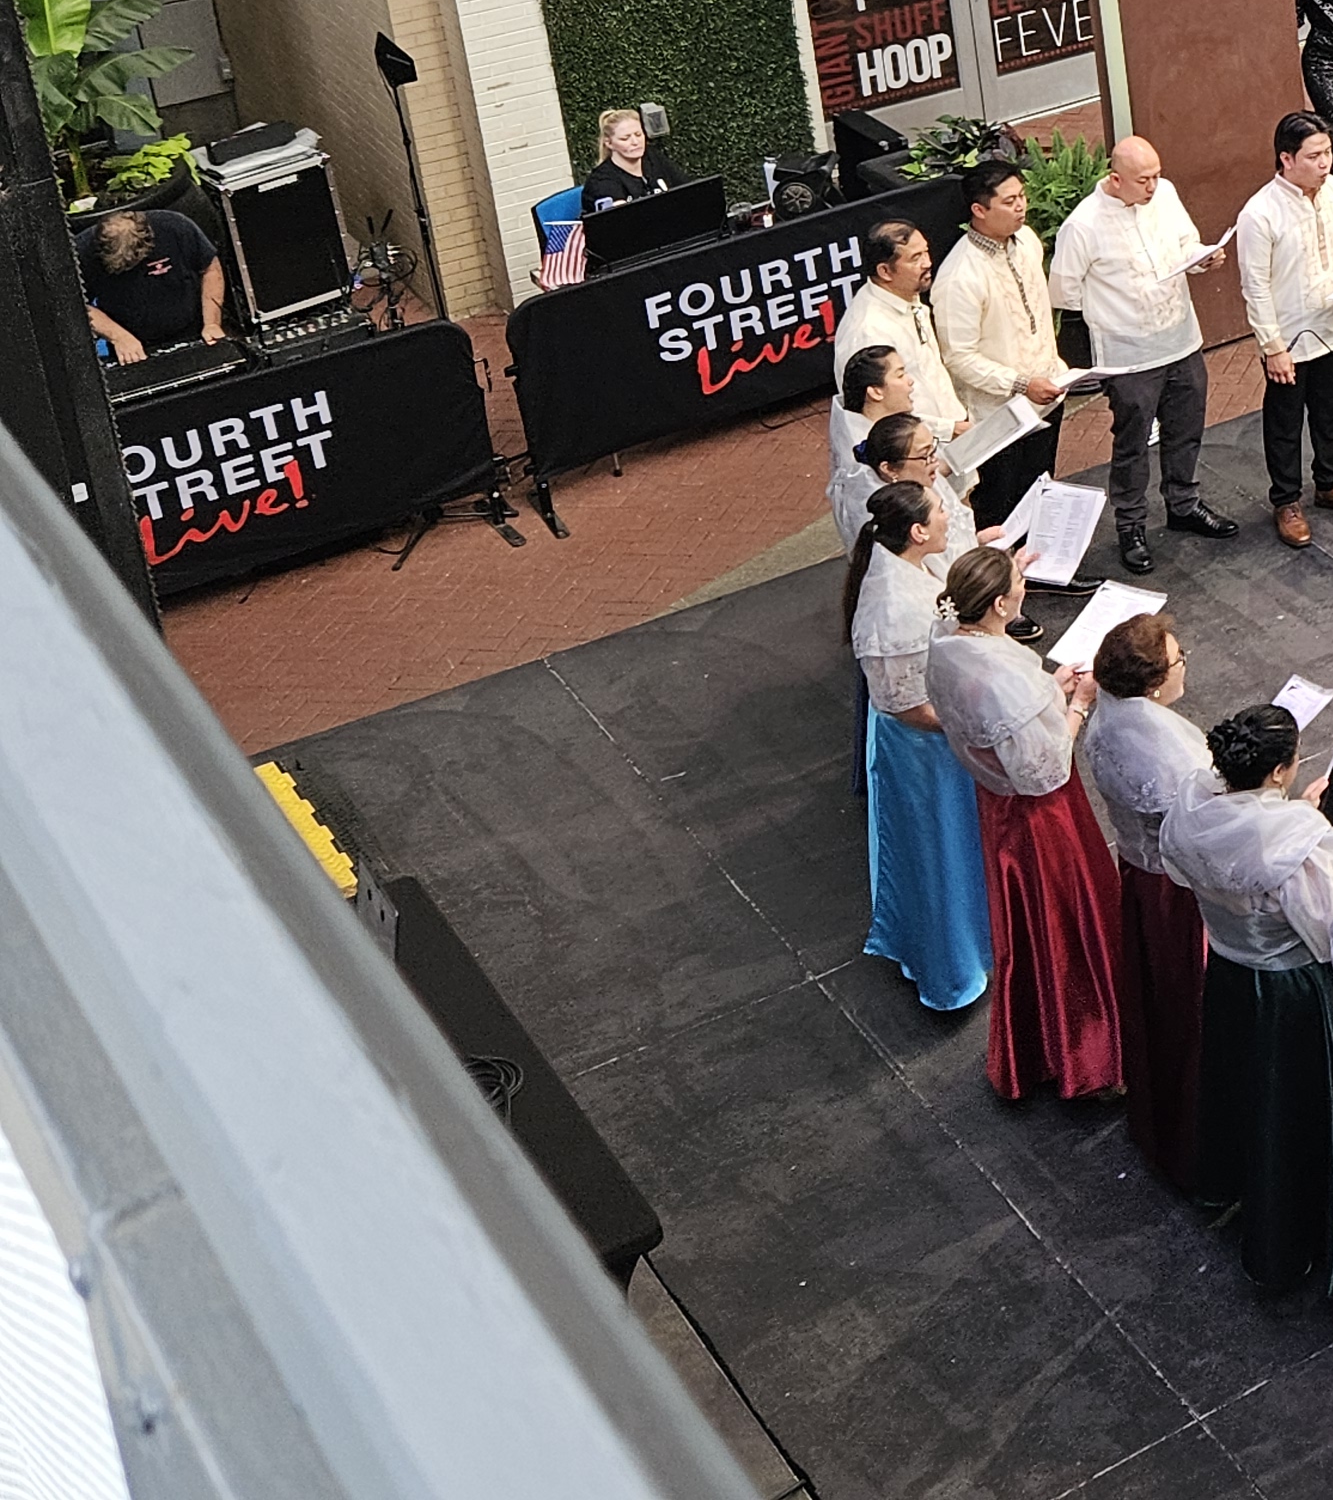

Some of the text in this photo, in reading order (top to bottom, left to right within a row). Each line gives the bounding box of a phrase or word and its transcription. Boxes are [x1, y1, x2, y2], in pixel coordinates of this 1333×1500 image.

[811, 18, 855, 106] GIANT
[857, 32, 953, 98] HOOP
[645, 236, 862, 330] FOURTH
[658, 273, 862, 362] STREET
[697, 300, 835, 395] Live!
[140, 460, 309, 566] Live!
